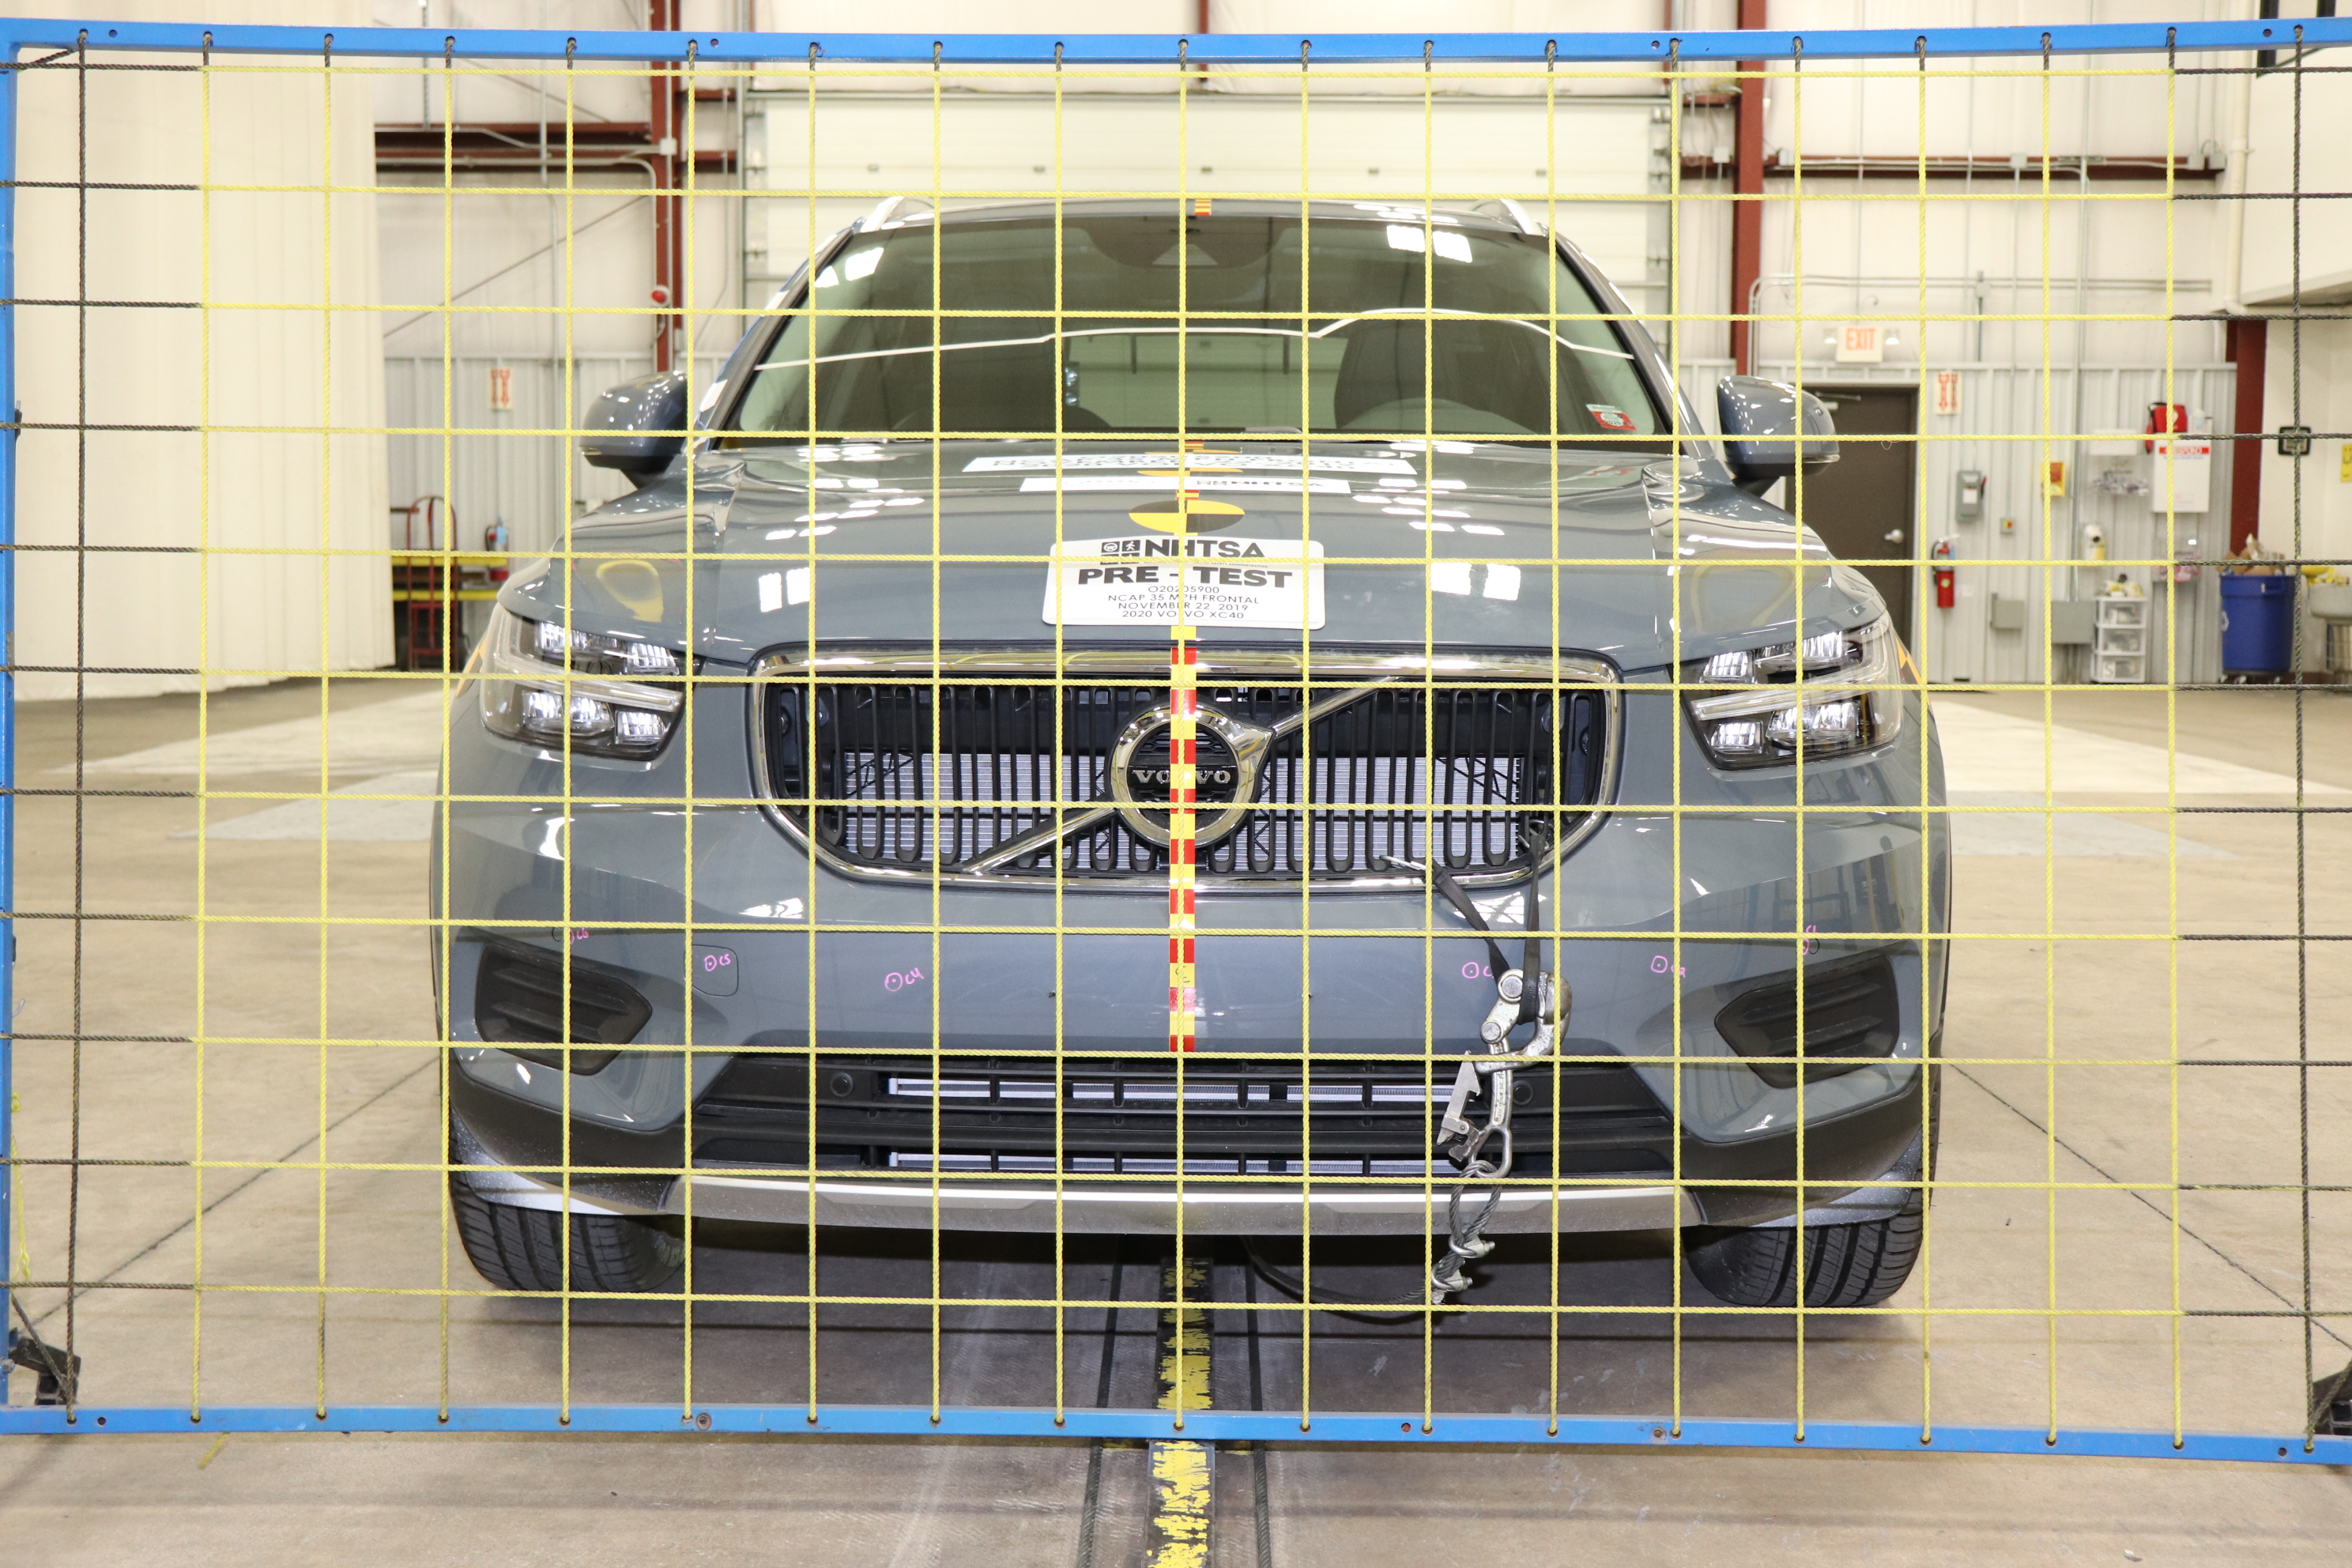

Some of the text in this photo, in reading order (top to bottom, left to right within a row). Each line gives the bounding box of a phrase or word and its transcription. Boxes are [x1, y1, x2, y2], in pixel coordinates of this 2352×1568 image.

[1845, 328, 1876, 350] EXIT
[1144, 539, 1265, 558] NHTSA
[1078, 566, 1159, 585] PRE
[1192, 566, 1293, 588] TEST
[1202, 594, 1260, 604] FRONTAL
[1132, 770, 1231, 785] VOVO
